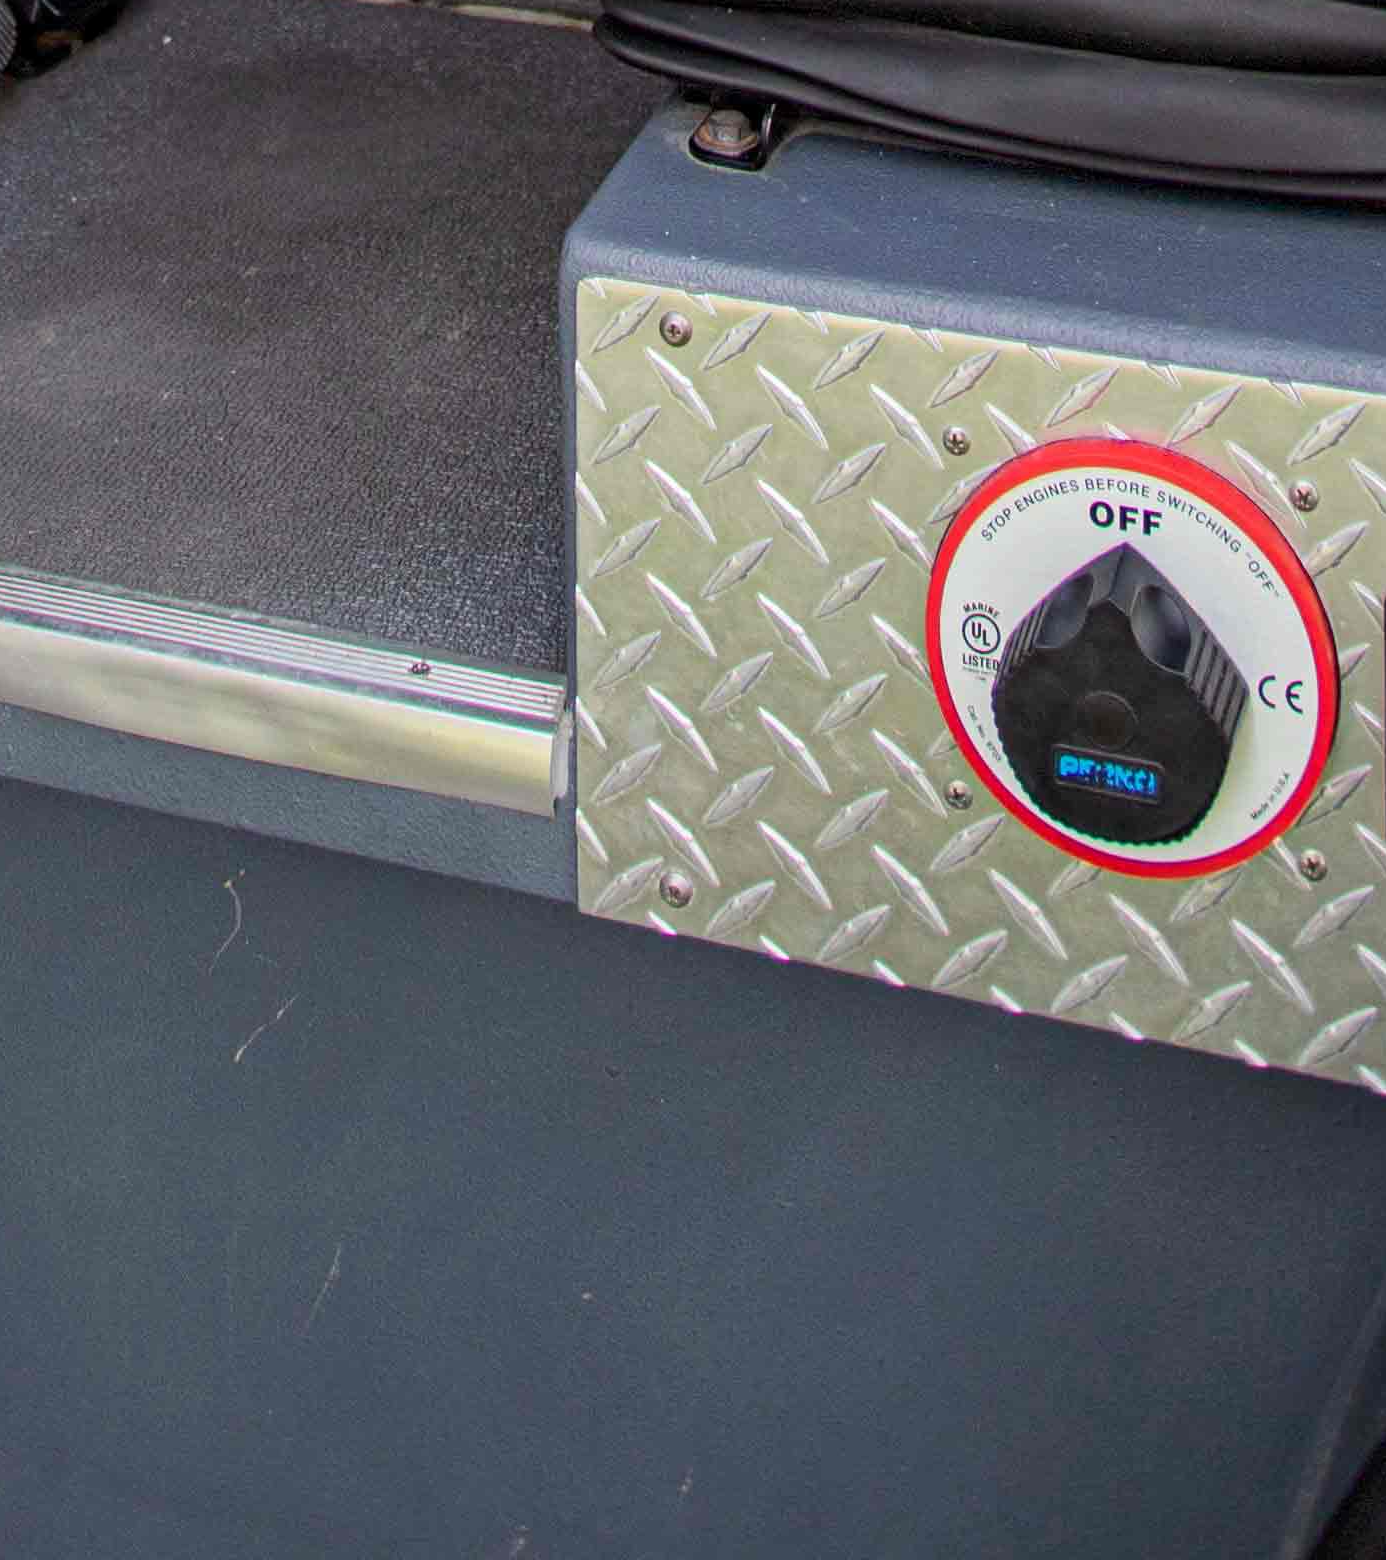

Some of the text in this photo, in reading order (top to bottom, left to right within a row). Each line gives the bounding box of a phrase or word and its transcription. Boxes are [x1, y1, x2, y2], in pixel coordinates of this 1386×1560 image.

[981, 510, 1014, 542] STOP
[1014, 479, 1080, 511] ENGINES
[1084, 478, 1150, 498] BEFORE
[1156, 490, 1243, 553] SWITCHING
[1089, 501, 1162, 537] OFF
[963, 602, 1000, 618] MARINE
[971, 621, 990, 647] UL
[963, 653, 999, 672] LISTED
